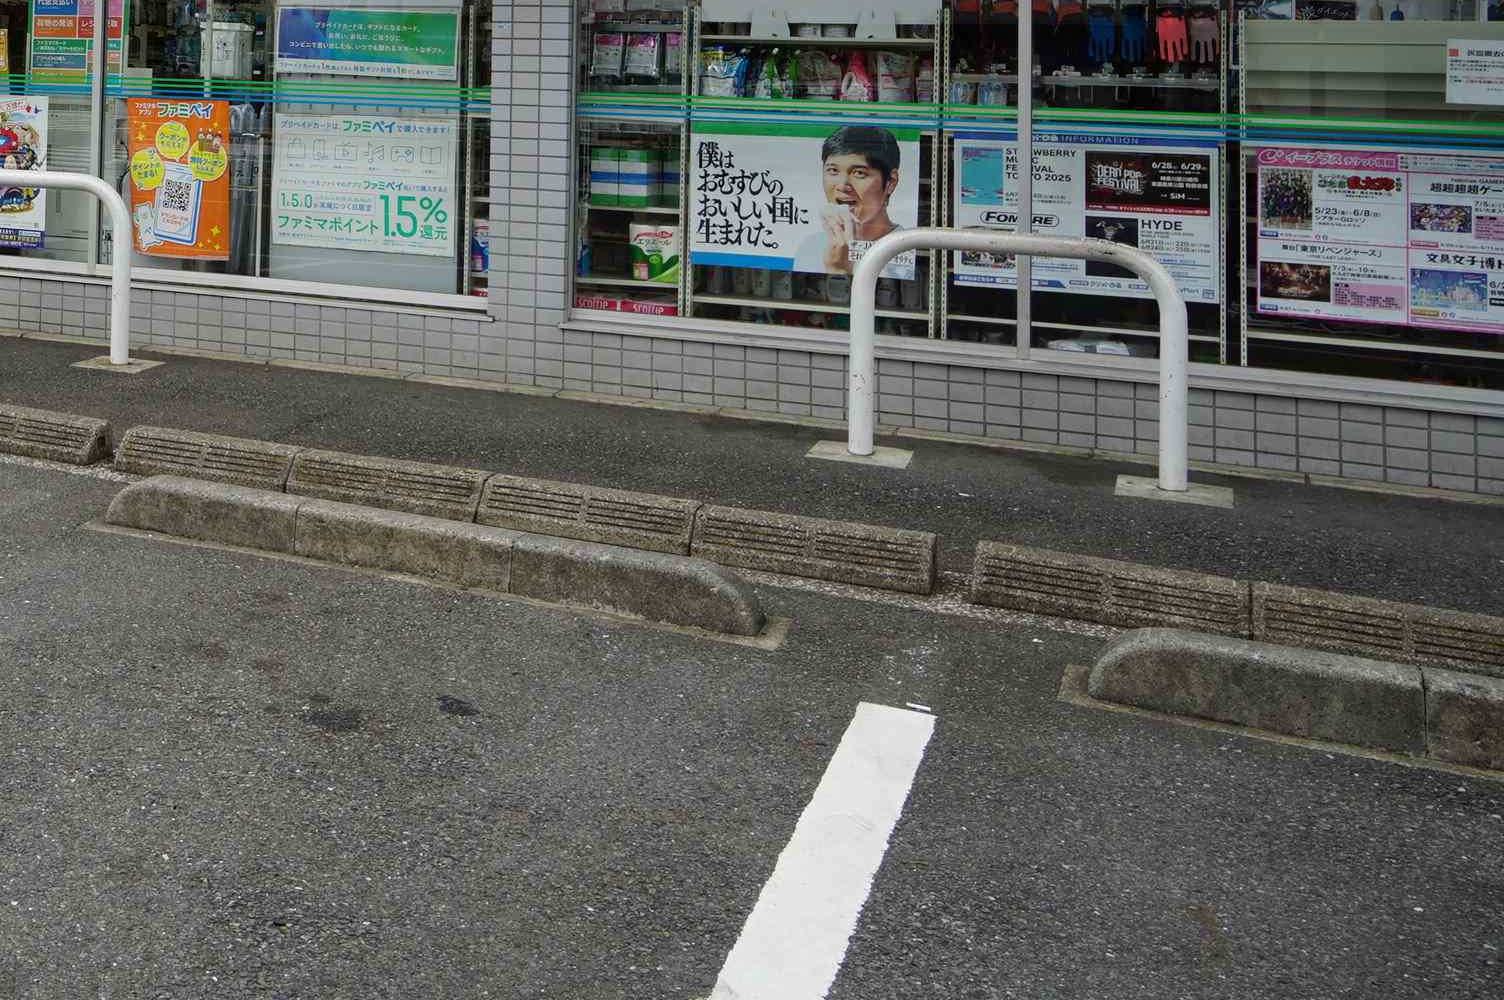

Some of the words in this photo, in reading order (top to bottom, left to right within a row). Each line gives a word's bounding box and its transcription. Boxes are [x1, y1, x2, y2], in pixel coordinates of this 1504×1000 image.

[157, 102, 214, 120] ファミペイ
[1061, 135, 1139, 145] INFORMATION
[697, 141, 734, 169] 僕は
[1006, 147, 1077, 158] STWBERRY
[1006, 164, 1055, 173] FEIVAL
[1044, 173, 1072, 182] 2025
[696, 170, 784, 196] おむすびの
[696, 196, 810, 226] おいしい国に
[985, 211, 1055, 226] FOMRE
[277, 215, 379, 236] ファミマポイント
[419, 223, 448, 241] 還元
[1141, 219, 1183, 231] HYDE
[696, 222, 779, 250] 生まれた。
